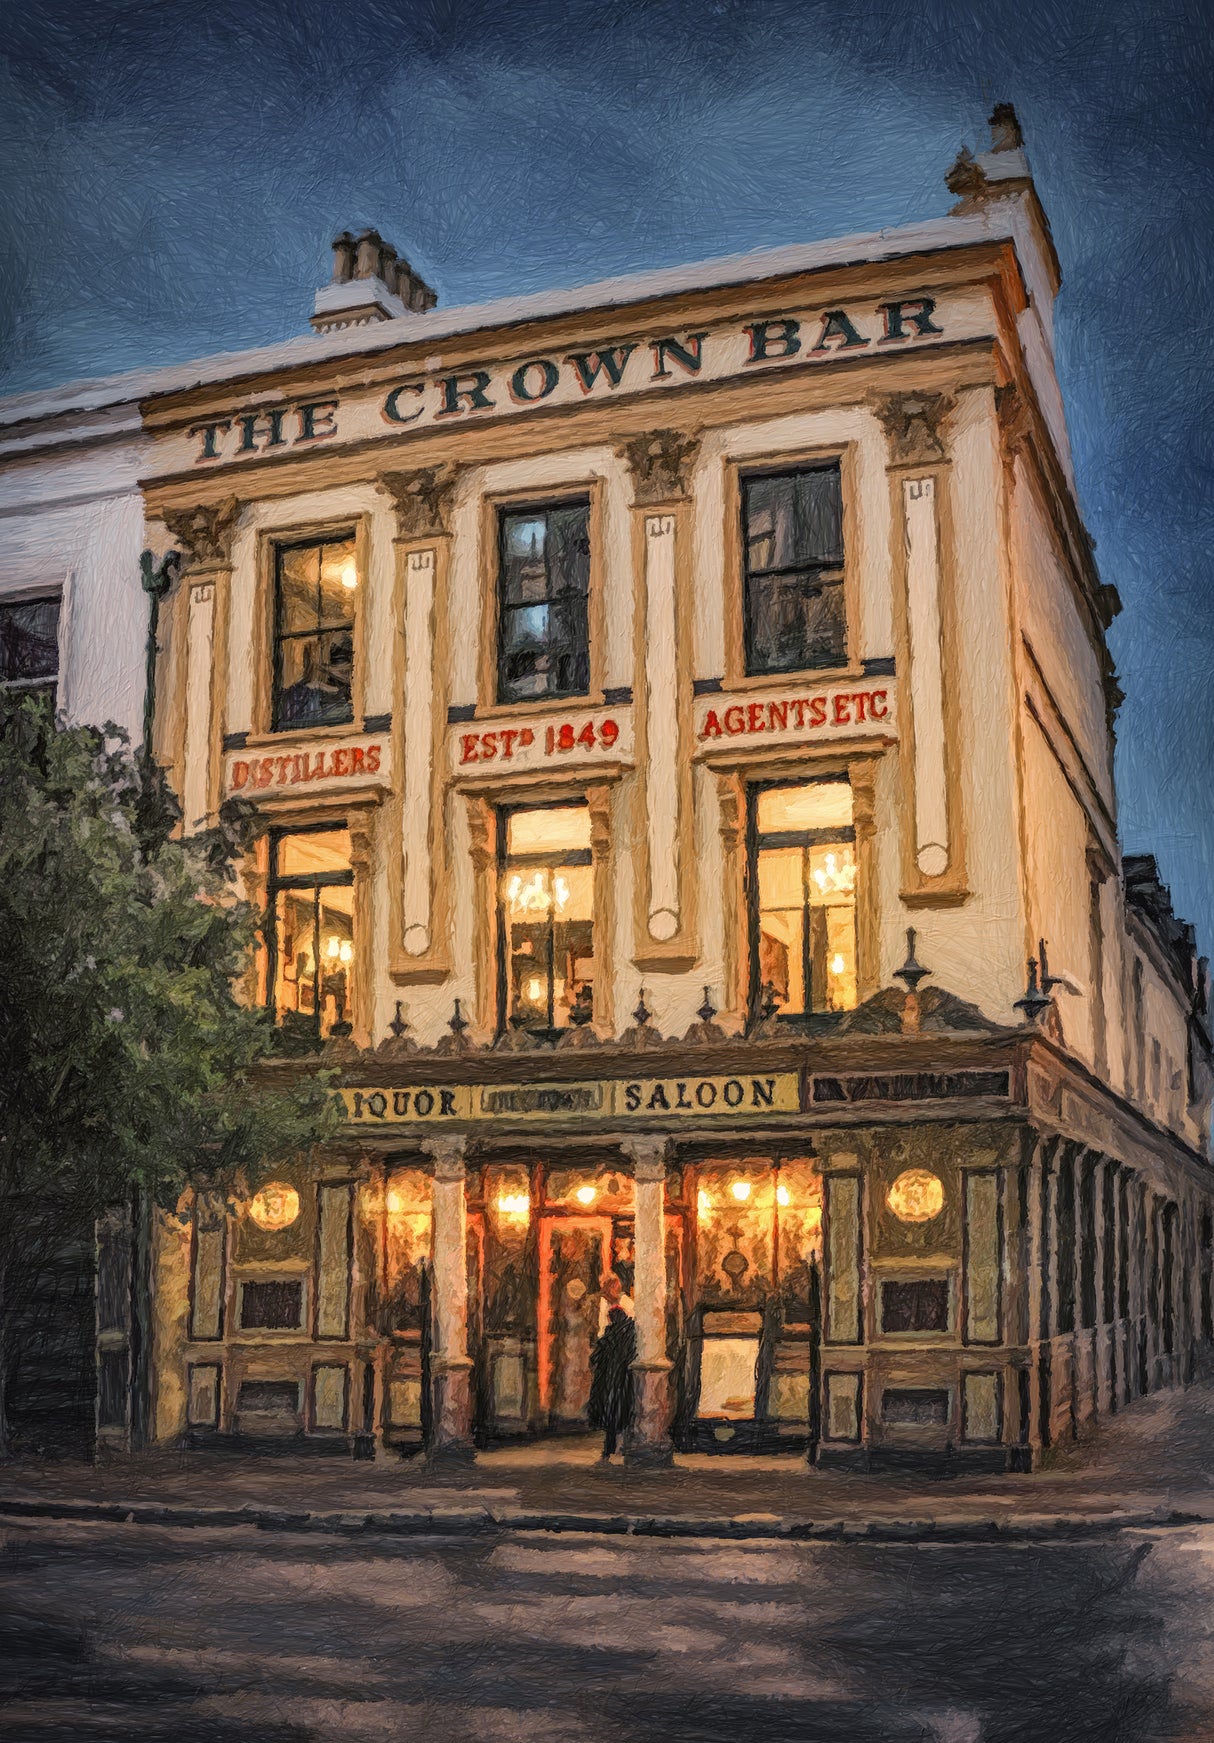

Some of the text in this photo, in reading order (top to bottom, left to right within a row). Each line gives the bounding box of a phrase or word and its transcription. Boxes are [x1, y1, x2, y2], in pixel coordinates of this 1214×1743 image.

[187, 298, 944, 463] THE CROWN BAR
[698, 690, 891, 741] AGENTS ETC
[545, 719, 621, 757] 1849
[229, 744, 382, 790] DISTILLERS
[344, 1089, 457, 1120] IQUOR
[625, 1078, 777, 1112] SALOON
